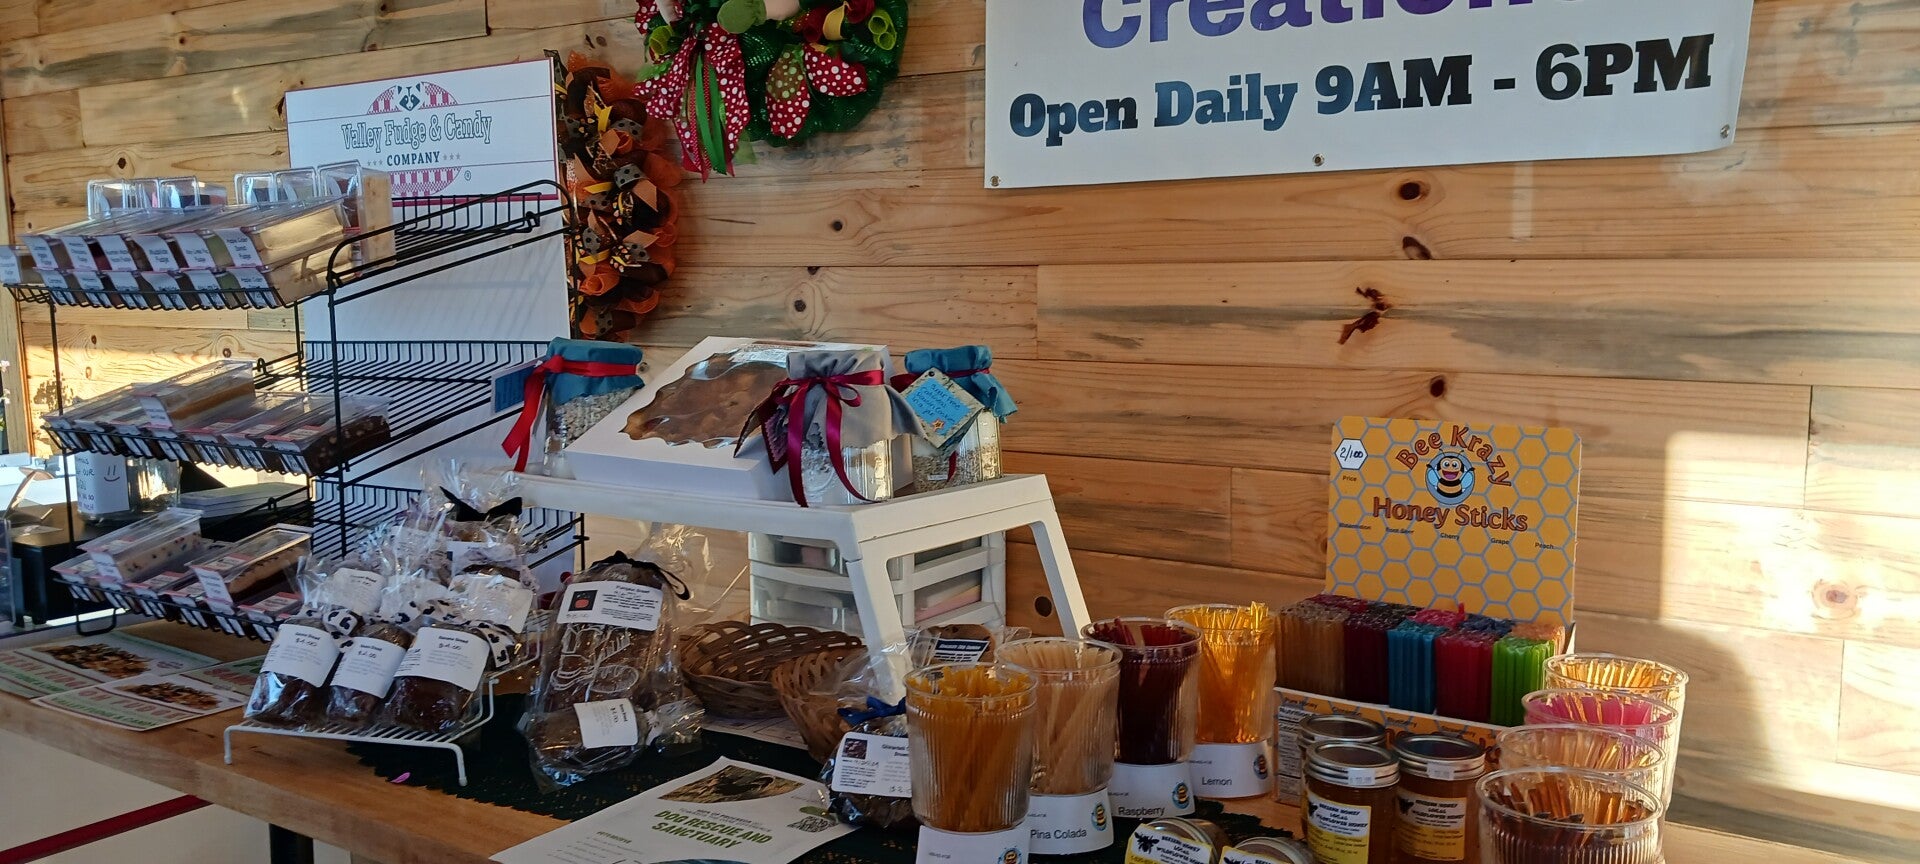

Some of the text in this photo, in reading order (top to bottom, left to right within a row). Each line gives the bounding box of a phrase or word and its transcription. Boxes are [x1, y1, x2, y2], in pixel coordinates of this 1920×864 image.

[1009, 93, 1138, 147] Open
[1154, 72, 1298, 131] Daily
[1315, 54, 1472, 115] 9AM
[1536, 33, 1714, 101] 6PM
[341, 110, 492, 153] Valley Fudge & Candy
[386, 151, 440, 166] COMPANY
[1395, 425, 1512, 488] Bee Krazy
[1373, 496, 1528, 532] Honey Sticks
[1440, 533, 1460, 541] Cherry
[1201, 777, 1232, 786] Lemon
[1118, 806, 1165, 817] Raspberry
[651, 822, 742, 849] SANCTUARY
[654, 810, 689, 823] DOG
[684, 818, 744, 836] RESCUE
[736, 831, 773, 844] AND
[1030, 828, 1087, 839] Pina Colada
